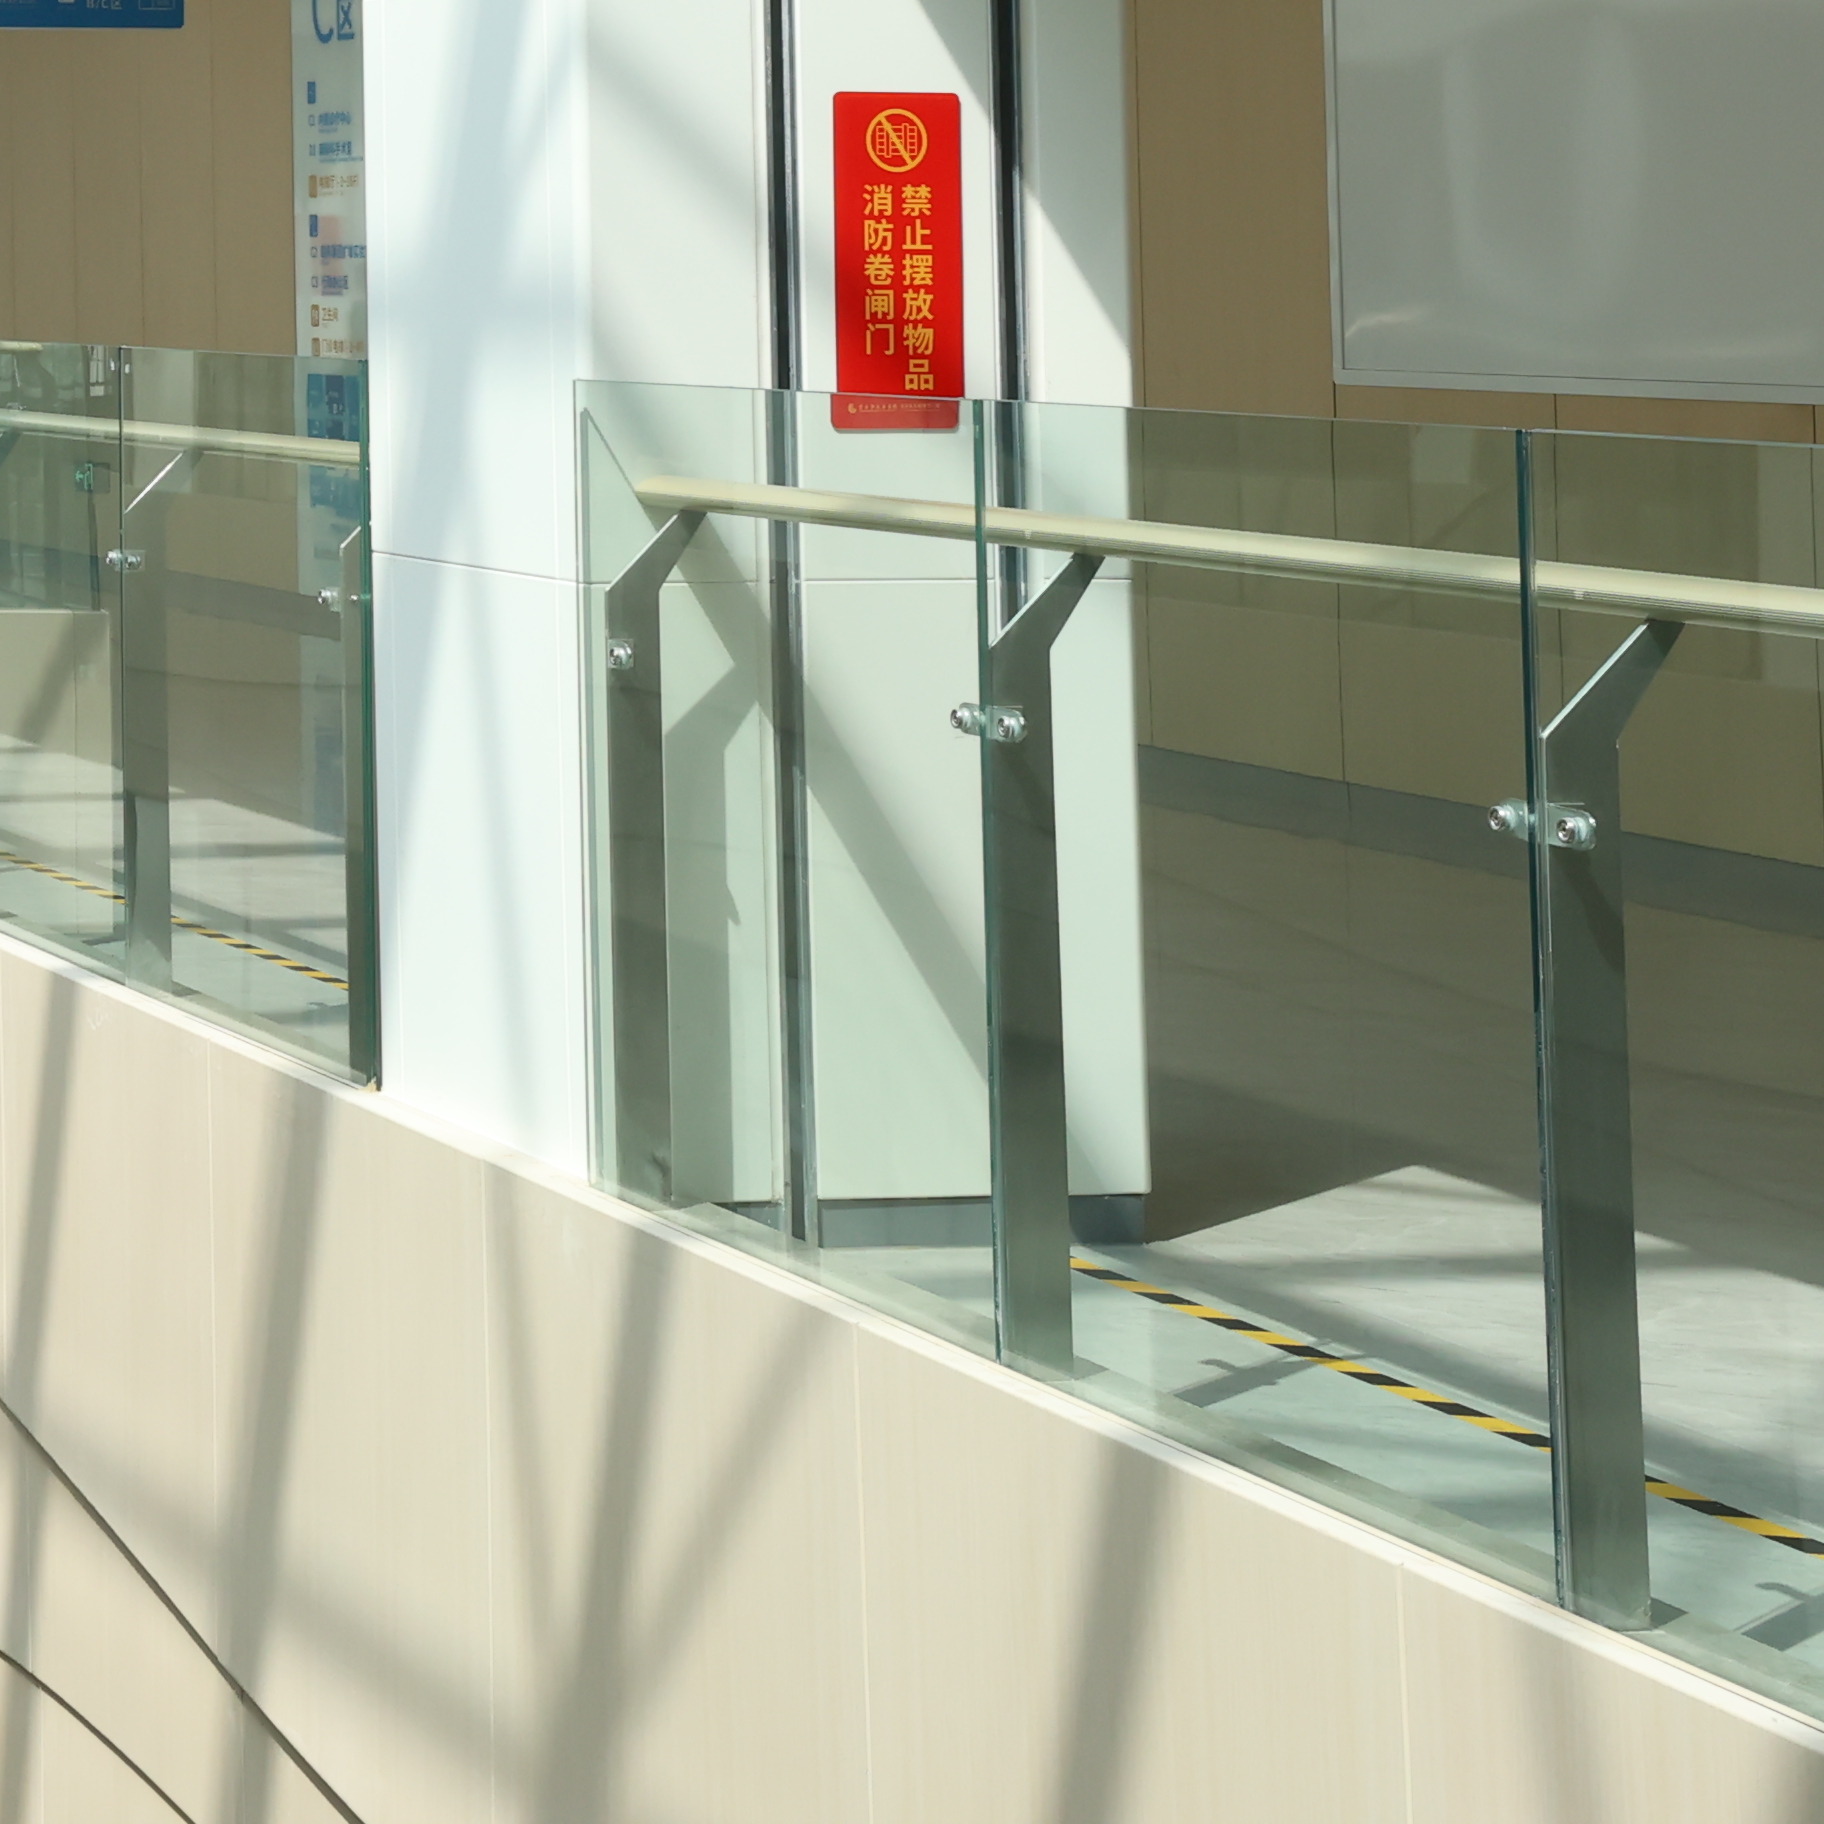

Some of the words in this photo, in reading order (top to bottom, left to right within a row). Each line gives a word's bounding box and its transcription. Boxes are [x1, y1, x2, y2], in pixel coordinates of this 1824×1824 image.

[862, 183, 895, 355] 消防卷闸门
[902, 184, 934, 390] 禁止摆放物品
